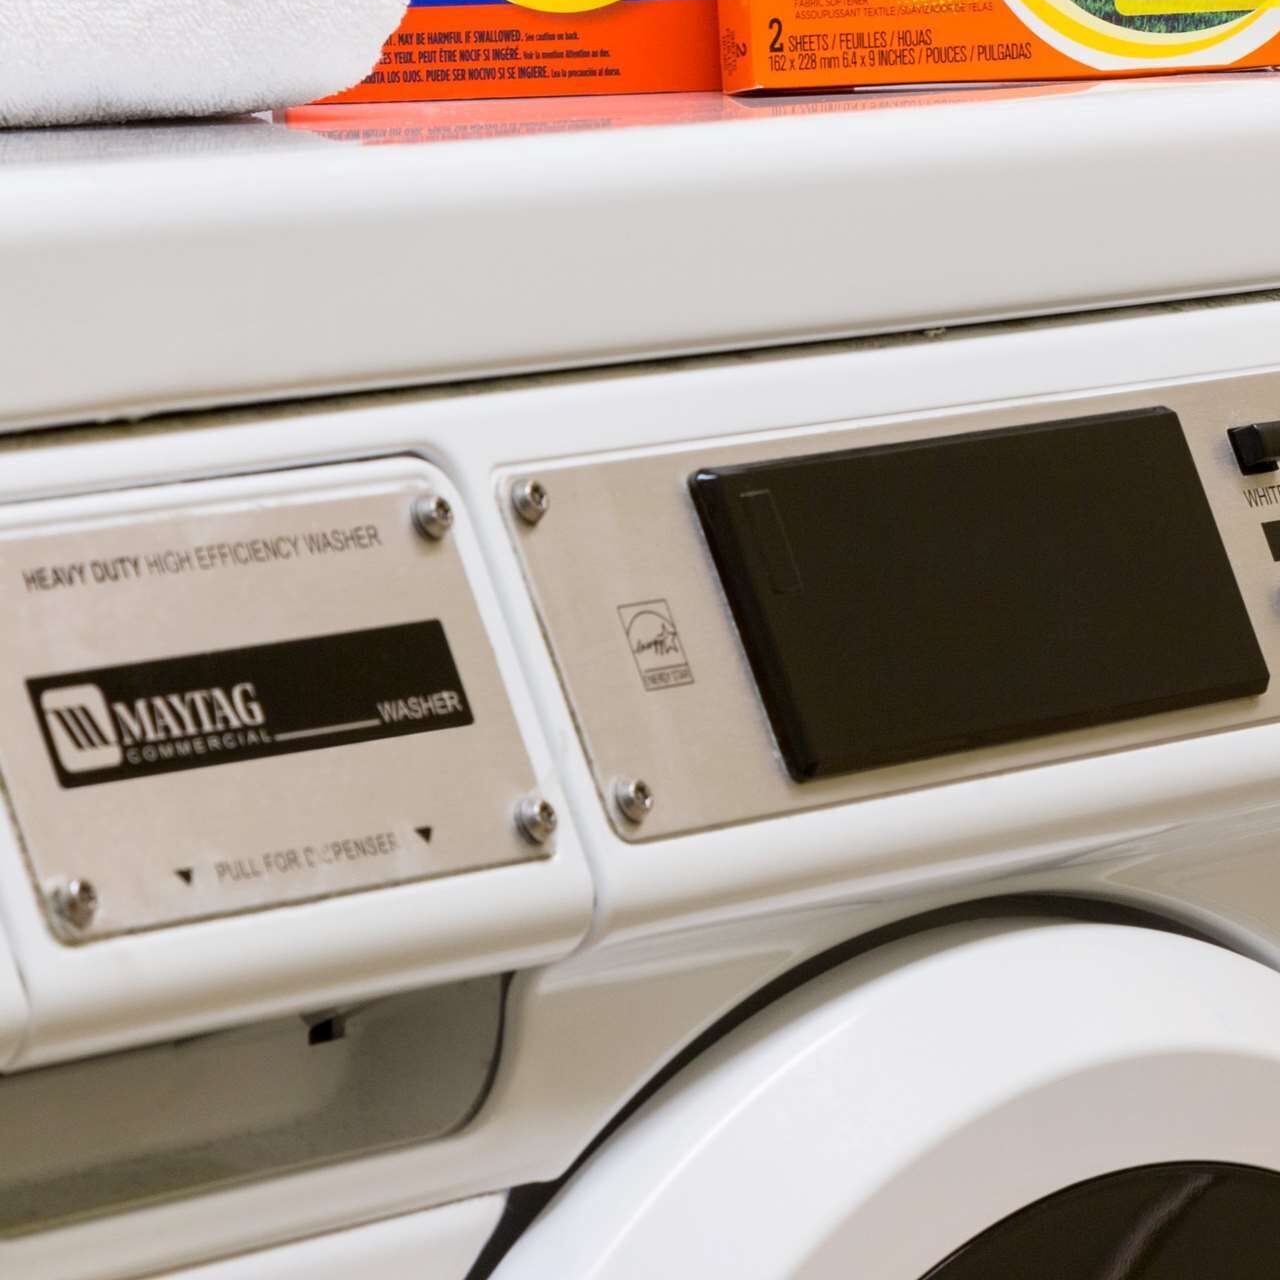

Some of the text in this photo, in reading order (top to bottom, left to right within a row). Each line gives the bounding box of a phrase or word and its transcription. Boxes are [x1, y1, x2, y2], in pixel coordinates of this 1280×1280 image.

[795, 7, 861, 20] ASSOUPLISSANT
[863, 6, 896, 17] TEXTILE
[966, 2, 993, 13] TELAS
[398, 32, 414, 45] MAY
[416, 32, 425, 45] BE
[427, 31, 462, 44] HARMFUL
[465, 30, 471, 43] IF
[768, 17, 784, 53] 2
[788, 33, 829, 52] SHEETS
[839, 31, 887, 49] FEUILLES
[897, 28, 932, 47] HOJAS
[418, 50, 437, 63] PEUT
[459, 49, 480, 62] NOCIF
[482, 48, 490, 61] SI
[768, 54, 786, 71] 162
[788, 59, 795, 70] x
[799, 53, 817, 70] 228
[819, 55, 839, 68] mm
[842, 52, 857, 68] 6.4
[860, 55, 866, 67] x
[868, 51, 875, 67] 9
[878, 48, 915, 66] INCHES
[926, 45, 967, 64] POUCES
[977, 42, 1032, 61] PULGADAS
[387, 70, 400, 83] LOS
[426, 69, 450, 82] PUEDE
[452, 68, 466, 81] SER
[468, 67, 496, 81] NOCIVO
[498, 67, 505, 80] SI
[507, 66, 516, 79] SE
[22, 525, 383, 592] HEAVY DUTY HIGH EFFICIENCY WASHER
[112, 683, 265, 745] MAYTAG
[126, 691, 464, 765] COMMERCIAL WASHER
[214, 858, 261, 883] PULL
[262, 849, 300, 873] FOR
